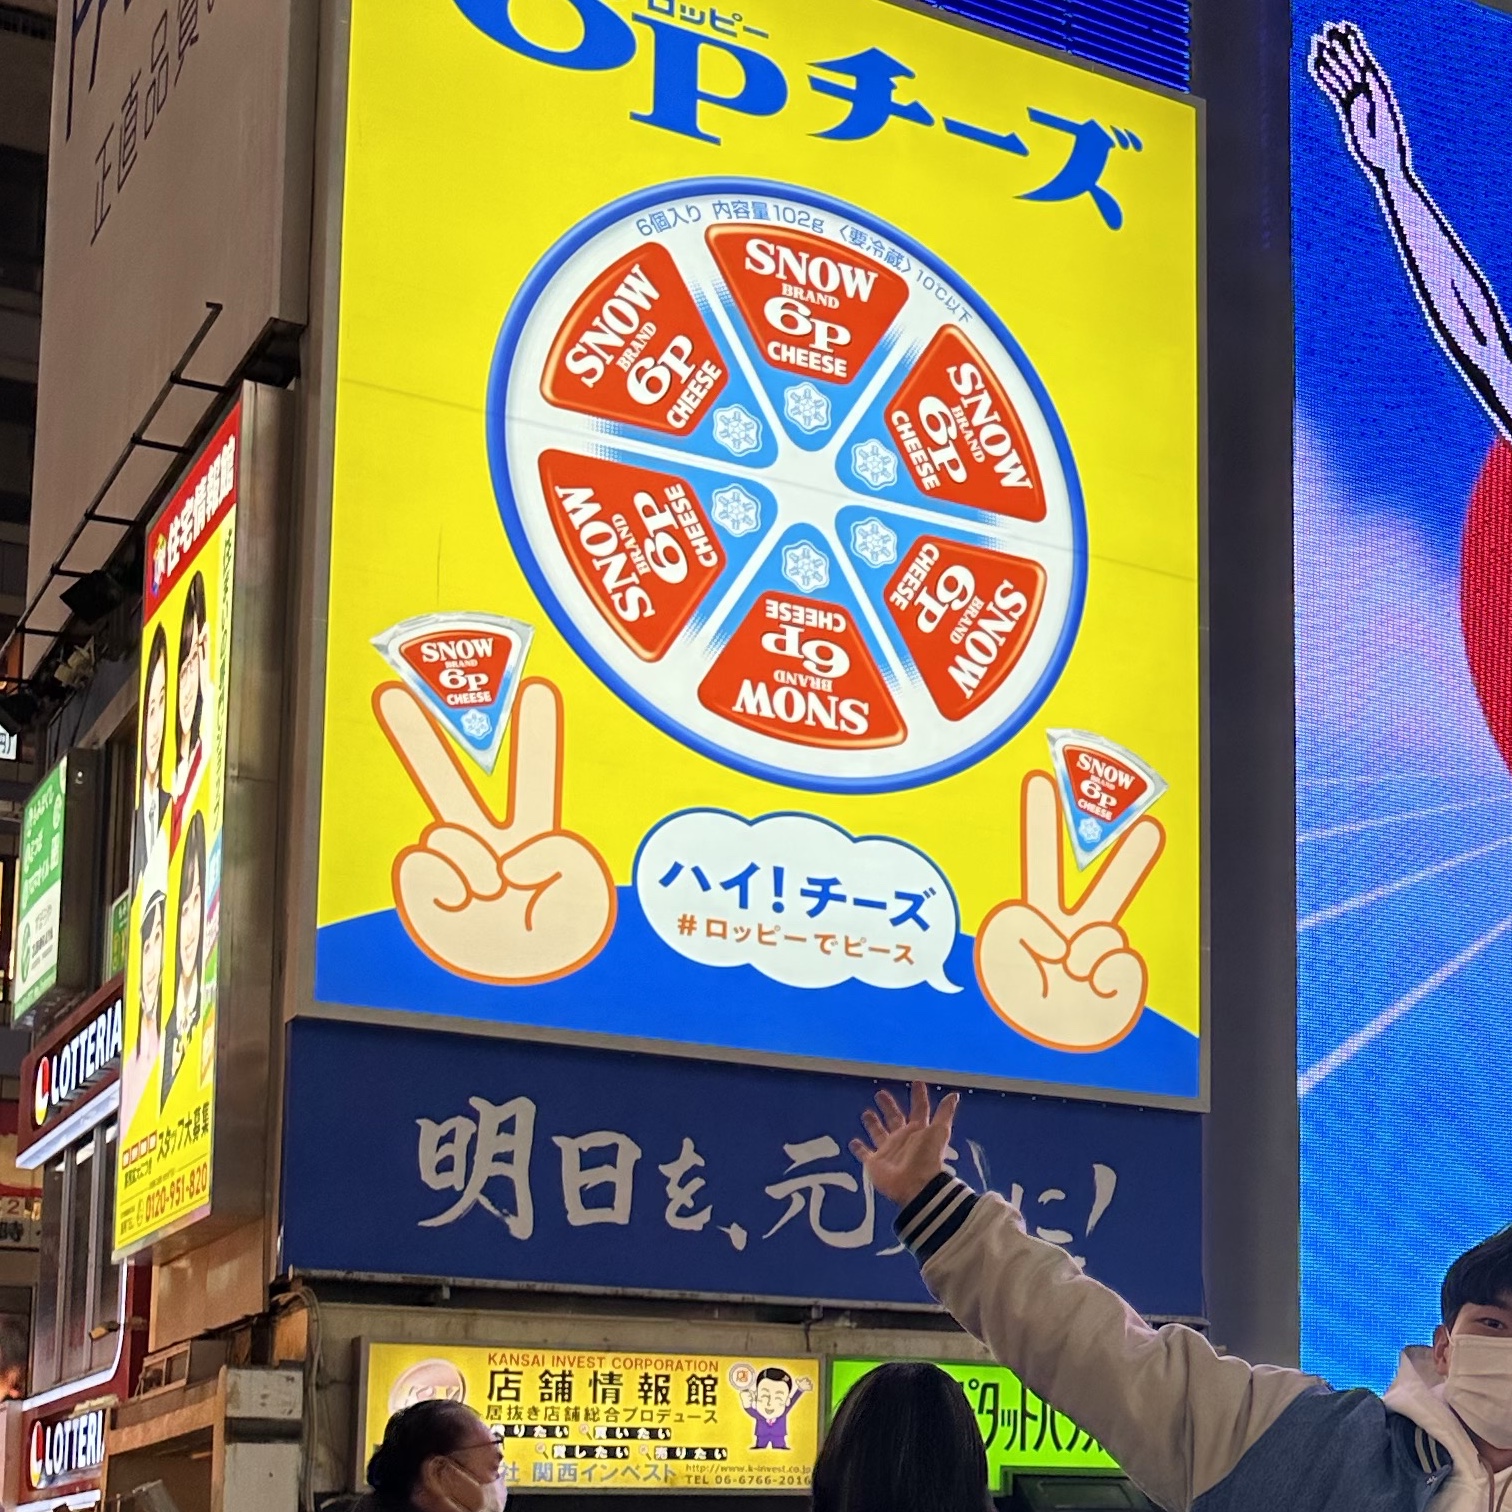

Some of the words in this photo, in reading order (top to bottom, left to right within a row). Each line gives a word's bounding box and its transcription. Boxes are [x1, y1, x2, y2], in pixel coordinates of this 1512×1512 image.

[635, 204, 702, 237] 6個入り
[712, 199, 824, 233] 内容量102g
[744, 238, 878, 303] SNOW
[780, 282, 840, 310] BRAND
[564, 264, 661, 387] SNOW
[619, 321, 657, 373] BRAND
[763, 297, 853, 353] 6P
[625, 334, 695, 405] 6P
[767, 340, 848, 377] CHEESE
[665, 359, 722, 430] CHEESE
[890, 410, 941, 491] CHEESE
[917, 395, 968, 484] 6P
[946, 361, 1032, 491] SNOW
[951, 405, 986, 463] BRAND
[611, 513, 650, 576] BRAND
[633, 491, 688, 585] 6P
[663, 482, 719, 569] CHEESE
[555, 485, 655, 623] SNOW
[889, 542, 940, 611] CHEESE
[765, 598, 847, 630] CHEESE
[915, 563, 977, 635] 6P
[950, 595, 985, 646] BRAND
[421, 638, 494, 664] SNOW
[761, 623, 850, 676] 6P
[946, 579, 1028, 699] SNOW
[439, 669, 489, 691] 6P
[446, 691, 492, 707] CHEESE
[732, 678, 869, 736] SNOW
[772, 669, 833, 691] BRAND
[1076, 753, 1135, 790] SNOW
[1080, 780, 1117, 809] 6P
[1077, 799, 1113, 820] CHEESE
[51, 999, 123, 1105] LOTTERIA
[416, 1095, 1117, 1268] 明日を、元に!
[487, 1368, 719, 1407] 店舗情報館
[488, 1353, 545, 1367] KANSAI
[552, 1355, 605, 1368] INVEST
[612, 1357, 719, 1372] CORPORATION
[486, 1404, 718, 1424] 居抜き店舗総合プロデュース
[45, 1410, 107, 1475] LOTTERI
[532, 1462, 676, 1482] 関西インベスト
[686, 1475, 709, 1485] TEL
